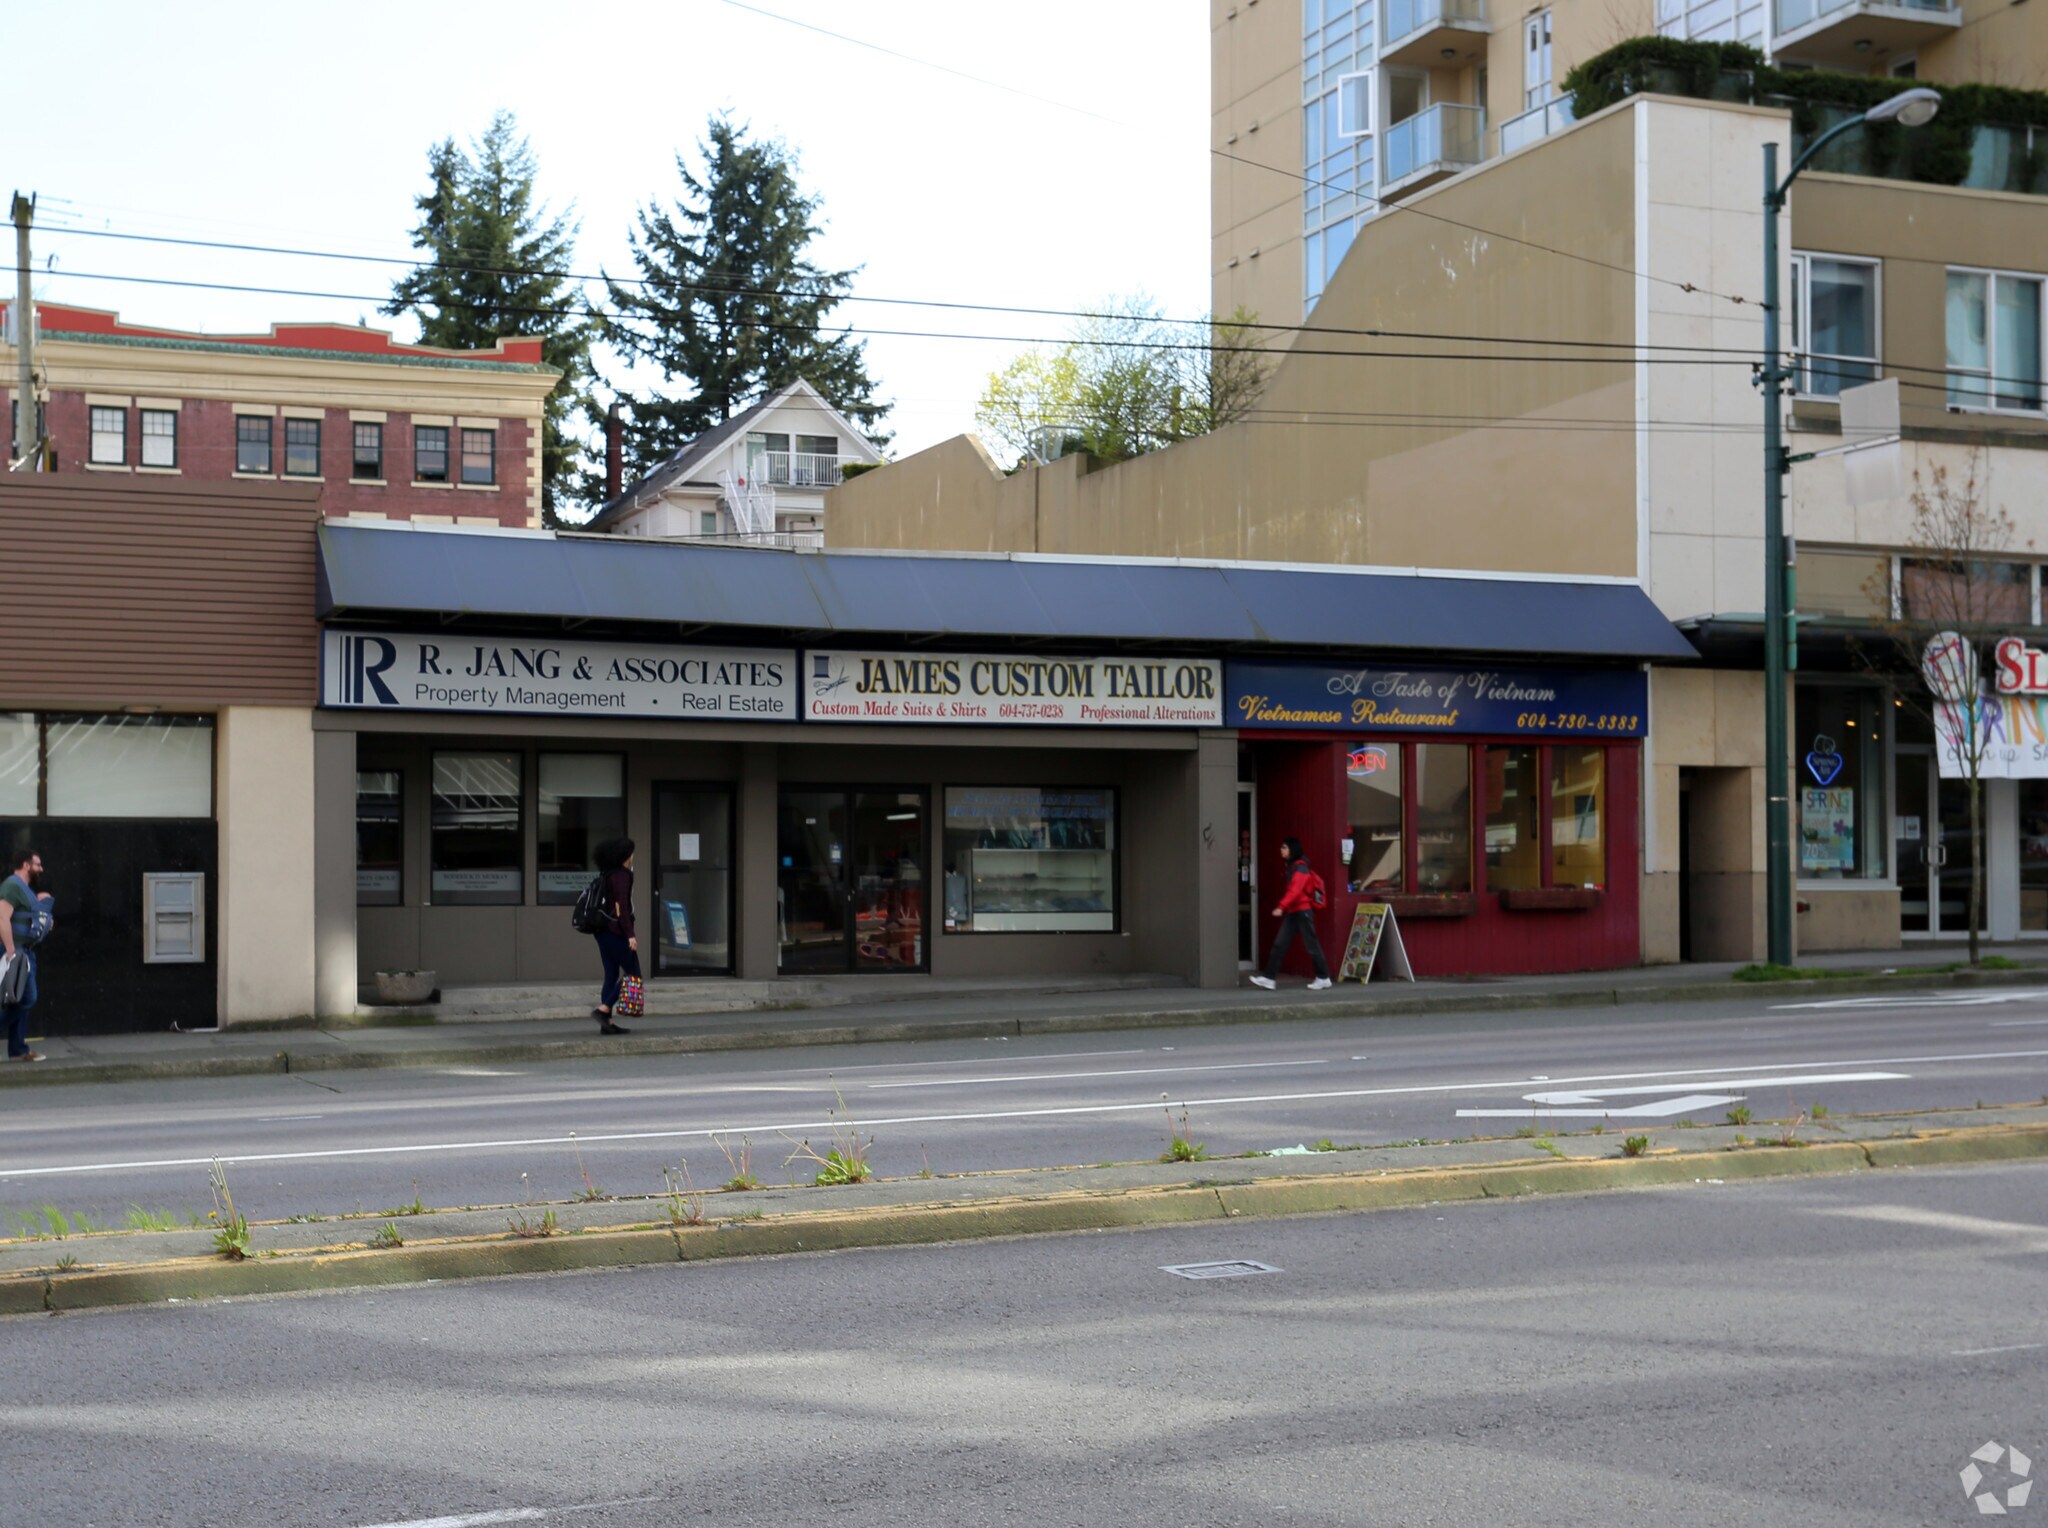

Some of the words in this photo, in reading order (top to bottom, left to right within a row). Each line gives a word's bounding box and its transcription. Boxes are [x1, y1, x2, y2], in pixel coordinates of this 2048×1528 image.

[417, 644, 453, 675] R.
[466, 646, 561, 681] JANG
[572, 656, 593, 681] &
[605, 657, 783, 688] ASSOCIATES
[855, 658, 963, 696] JAMES
[969, 660, 1095, 699] CUSTOM
[1103, 663, 1216, 700] TAILOR
[415, 683, 498, 707] Property
[505, 687, 626, 710] Management
[682, 693, 722, 711] Real
[728, 695, 785, 713] Estate
[1327, 668, 1365, 696] A
[1372, 671, 1432, 699] Taste
[1438, 674, 1470, 708] of
[1468, 671, 1556, 702] Vietnam
[812, 699, 860, 717] Custom
[863, 701, 898, 717] Made
[902, 701, 933, 717] Suits
[936, 702, 948, 717] &
[950, 701, 987, 718] Shirts
[999, 703, 1064, 719] 604-737-0238
[1081, 704, 1151, 721] Professional
[1153, 704, 1216, 721] Alterations
[1238, 695, 1342, 724] Vietnamese
[1351, 698, 1459, 727] Restaurant
[1517, 713, 1638, 731] 604-730-8383
